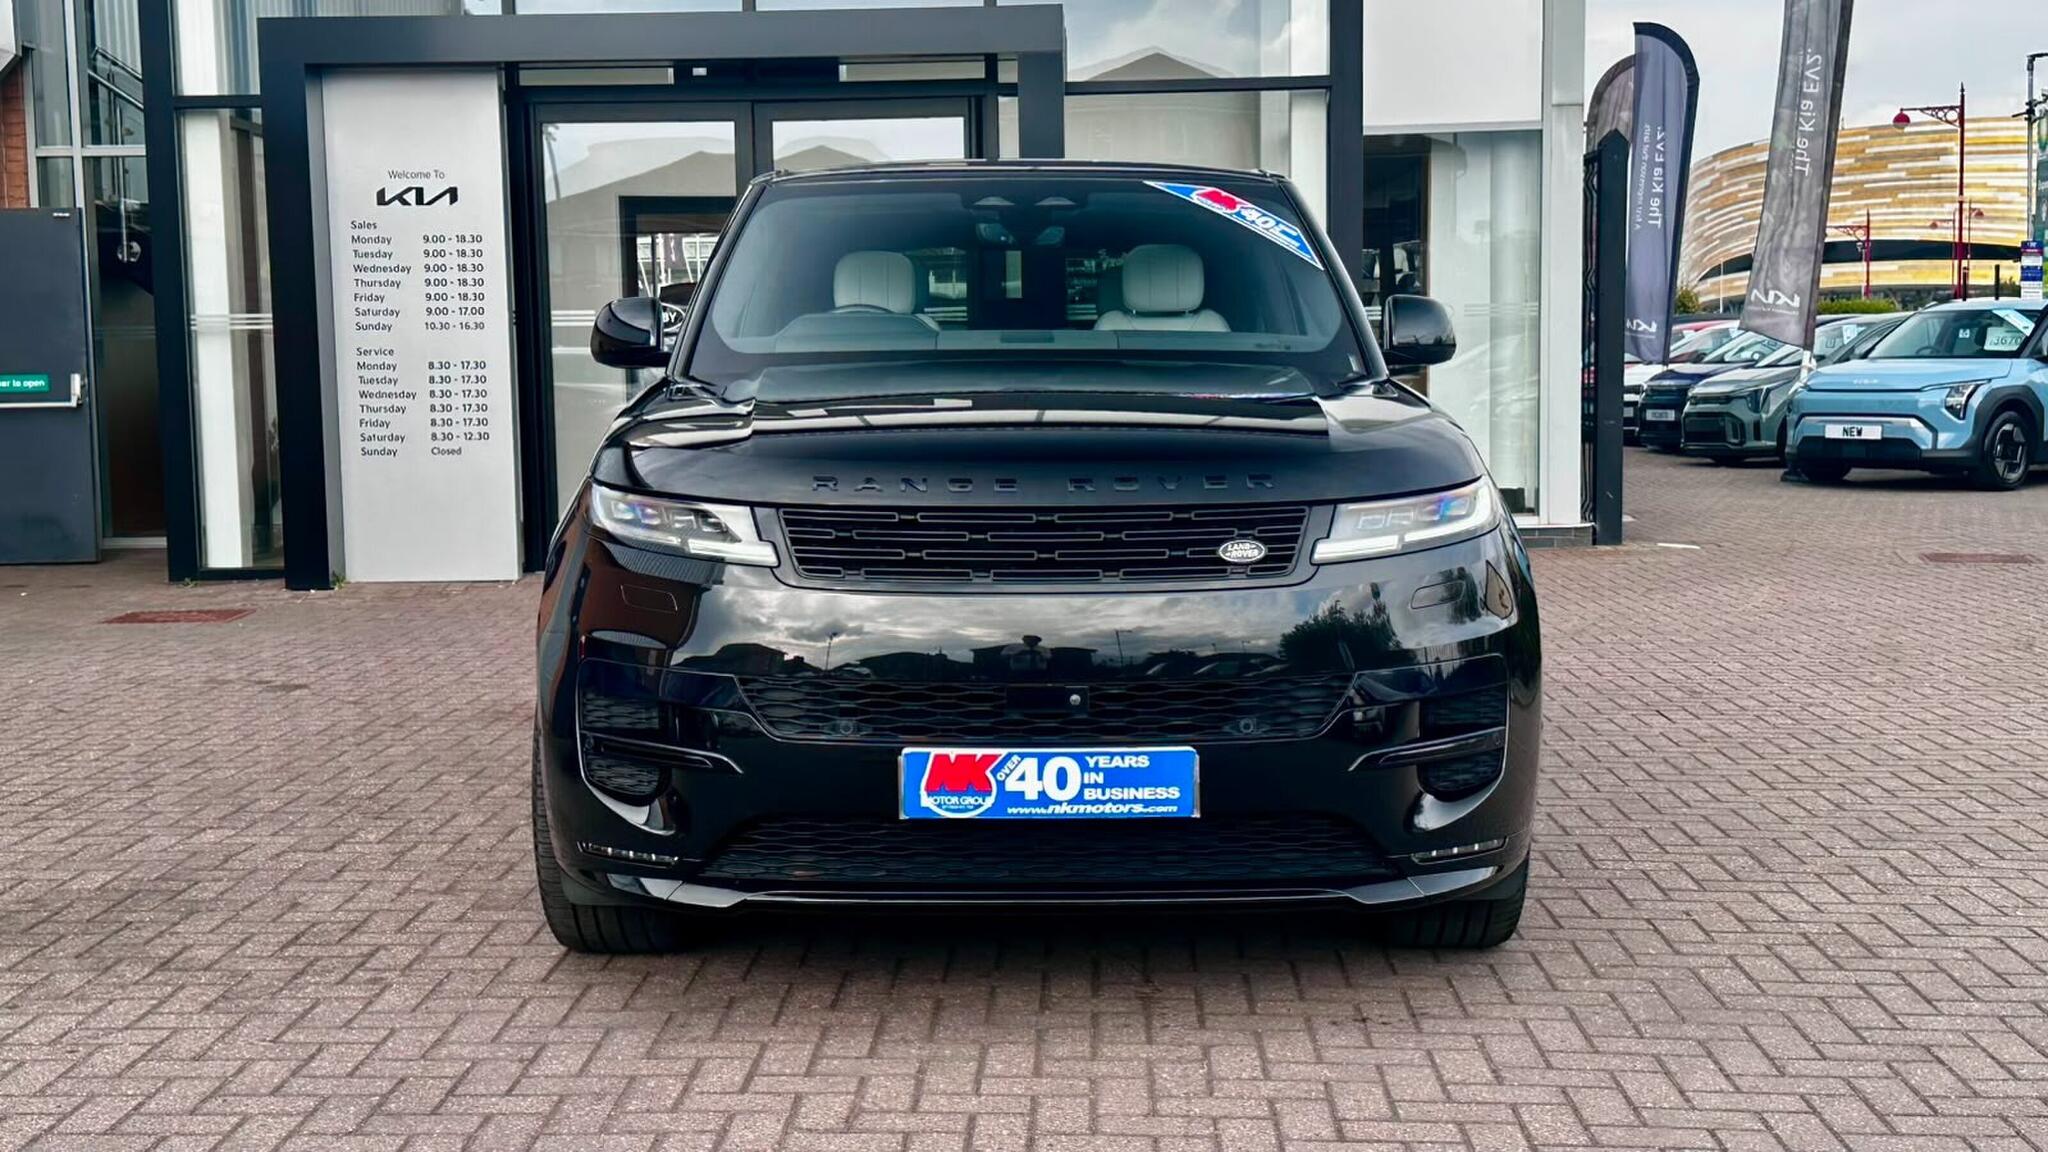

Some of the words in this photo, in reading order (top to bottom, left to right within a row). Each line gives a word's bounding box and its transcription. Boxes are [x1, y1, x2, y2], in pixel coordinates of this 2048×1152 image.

[388, 170, 431, 180] Welcome
[434, 170, 445, 180] To
[376, 186, 459, 206] KIA
[350, 220, 378, 230] Sales
[351, 235, 392, 245] Monday
[422, 234, 446, 244] 9.00
[455, 234, 483, 244] 18.30
[352, 250, 393, 260] Tuesday
[423, 249, 446, 258] 9.00
[456, 249, 483, 258] 18.30
[352, 264, 412, 274] Wednesday
[424, 264, 447, 273] 9.00
[457, 263, 484, 272] 18.30
[353, 279, 401, 289] Thursday
[424, 278, 448, 287] 9.00
[457, 278, 485, 287] 18.30
[353, 293, 385, 303] Friday
[425, 292, 448, 302] 9.00
[458, 292, 485, 301] 18.30
[354, 307, 400, 318] Saturday
[426, 307, 449, 316] 9.00
[458, 306, 485, 316] 17.00
[355, 322, 392, 332] Sunday
[424, 322, 450, 330] 10.30
[459, 321, 485, 330] 16.30
[356, 347, 394, 357] Service
[356, 361, 397, 372] Monday
[428, 361, 451, 370] 8.30
[461, 361, 487, 370] 17.30
[12, 379, 21, 387] to
[23, 380, 45, 389] open
[358, 375, 398, 386] Tuesday
[428, 375, 451, 384] 8.30
[461, 375, 487, 384] 17.30
[358, 390, 417, 400] Wednesday
[429, 389, 452, 398] 8.30
[462, 389, 488, 398] 17.30
[359, 404, 407, 414] Thursday
[429, 404, 452, 413] 8.30
[462, 403, 488, 412] 17.30
[359, 419, 391, 429] Friday
[430, 418, 453, 427] 8.30
[463, 418, 489, 427] 17.30
[1843, 426, 1863, 437] NEW
[360, 433, 405, 443] Saturday
[431, 432, 454, 441] 8.30
[463, 432, 490, 441] 12.30
[361, 448, 398, 458] Sunday
[431, 447, 462, 456] Closed
[811, 475, 1018, 492] RANGE
[1067, 474, 1275, 492] ROVER
[1085, 755, 1150, 768] YEARS
[996, 755, 1021, 781] OVER
[1004, 756, 1082, 801] 40
[1083, 772, 1104, 784] IN
[1083, 786, 1181, 800] BUSINESS
[1007, 802, 1178, 815] www.nkmotors.com
